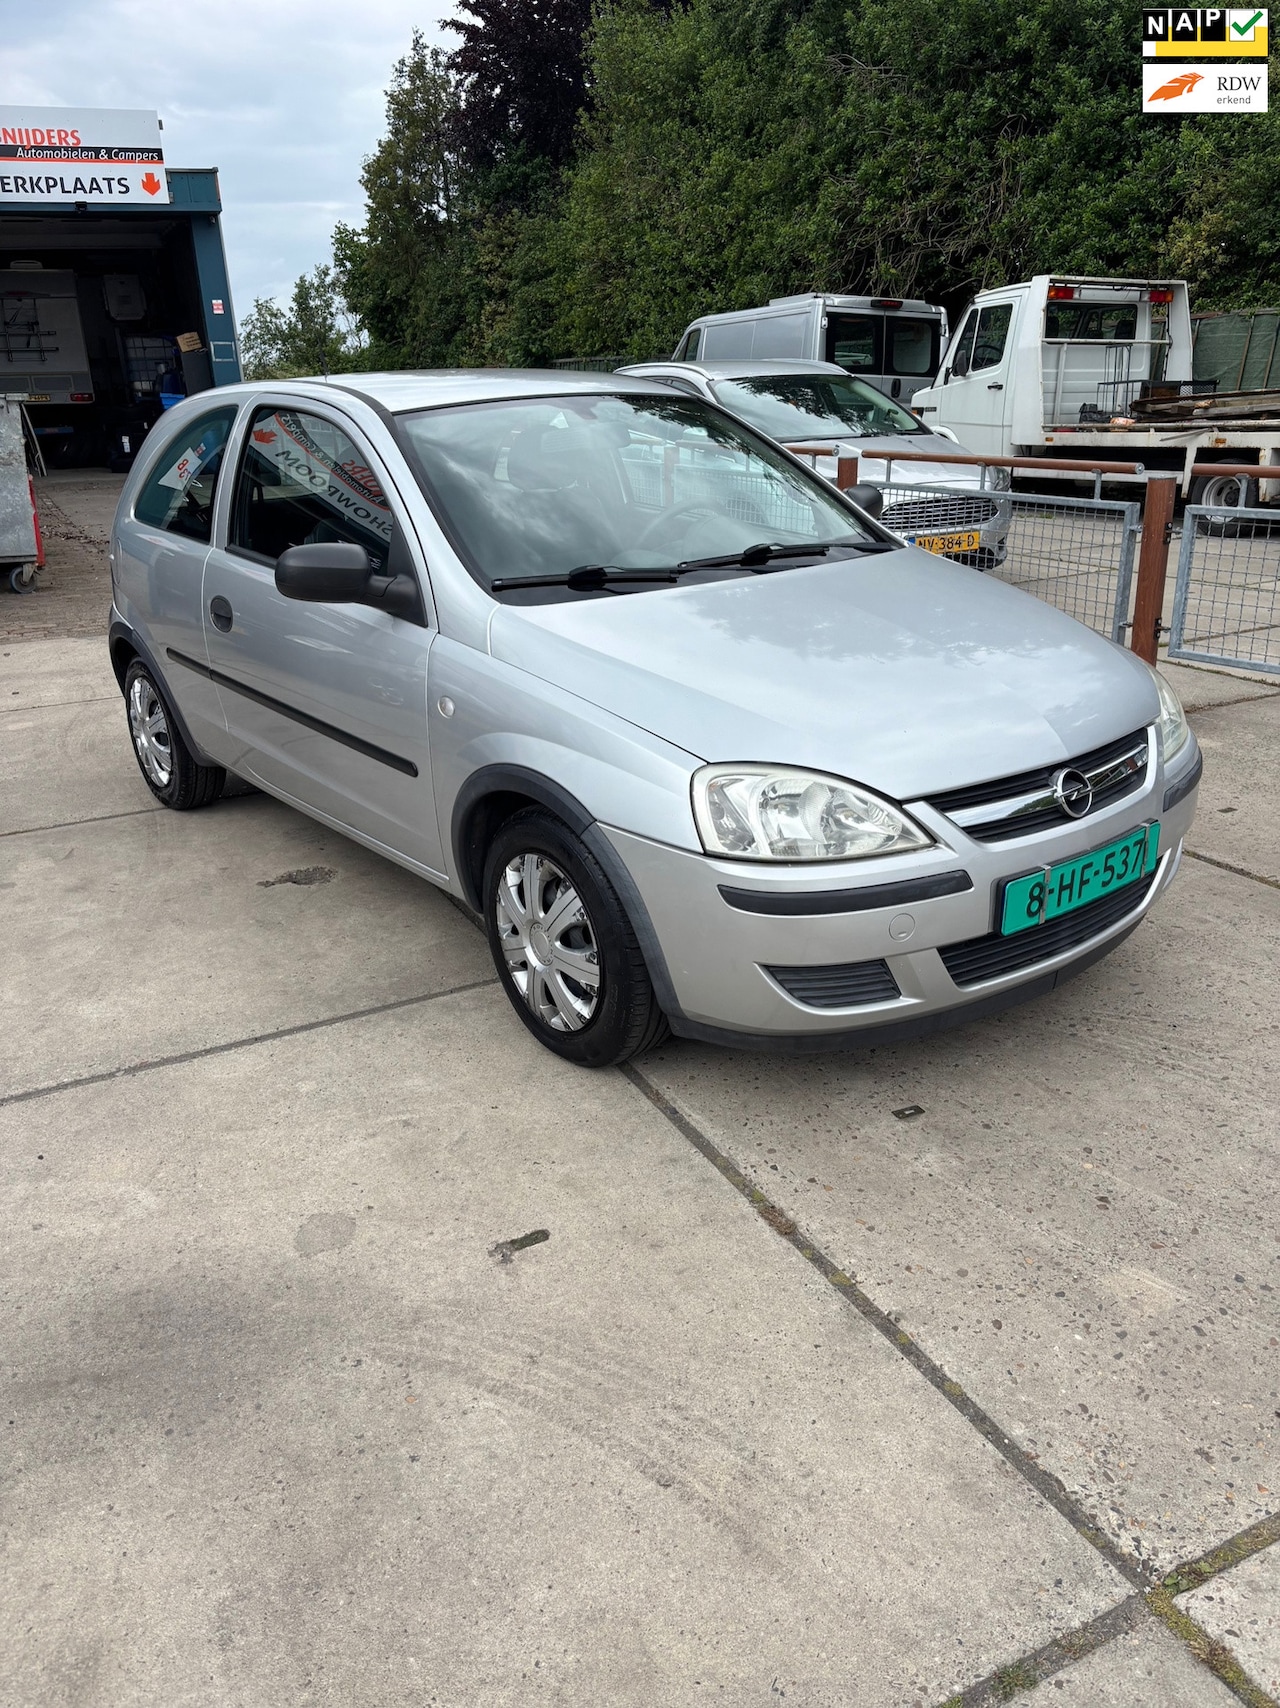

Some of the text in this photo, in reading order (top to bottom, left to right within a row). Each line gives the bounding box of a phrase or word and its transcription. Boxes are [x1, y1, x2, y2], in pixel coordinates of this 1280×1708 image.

[0, 128, 81, 149] NIJDERS
[17, 147, 158, 163] Automobielen & Campers
[1026, 838, 1145, 917] 8-HF-537
